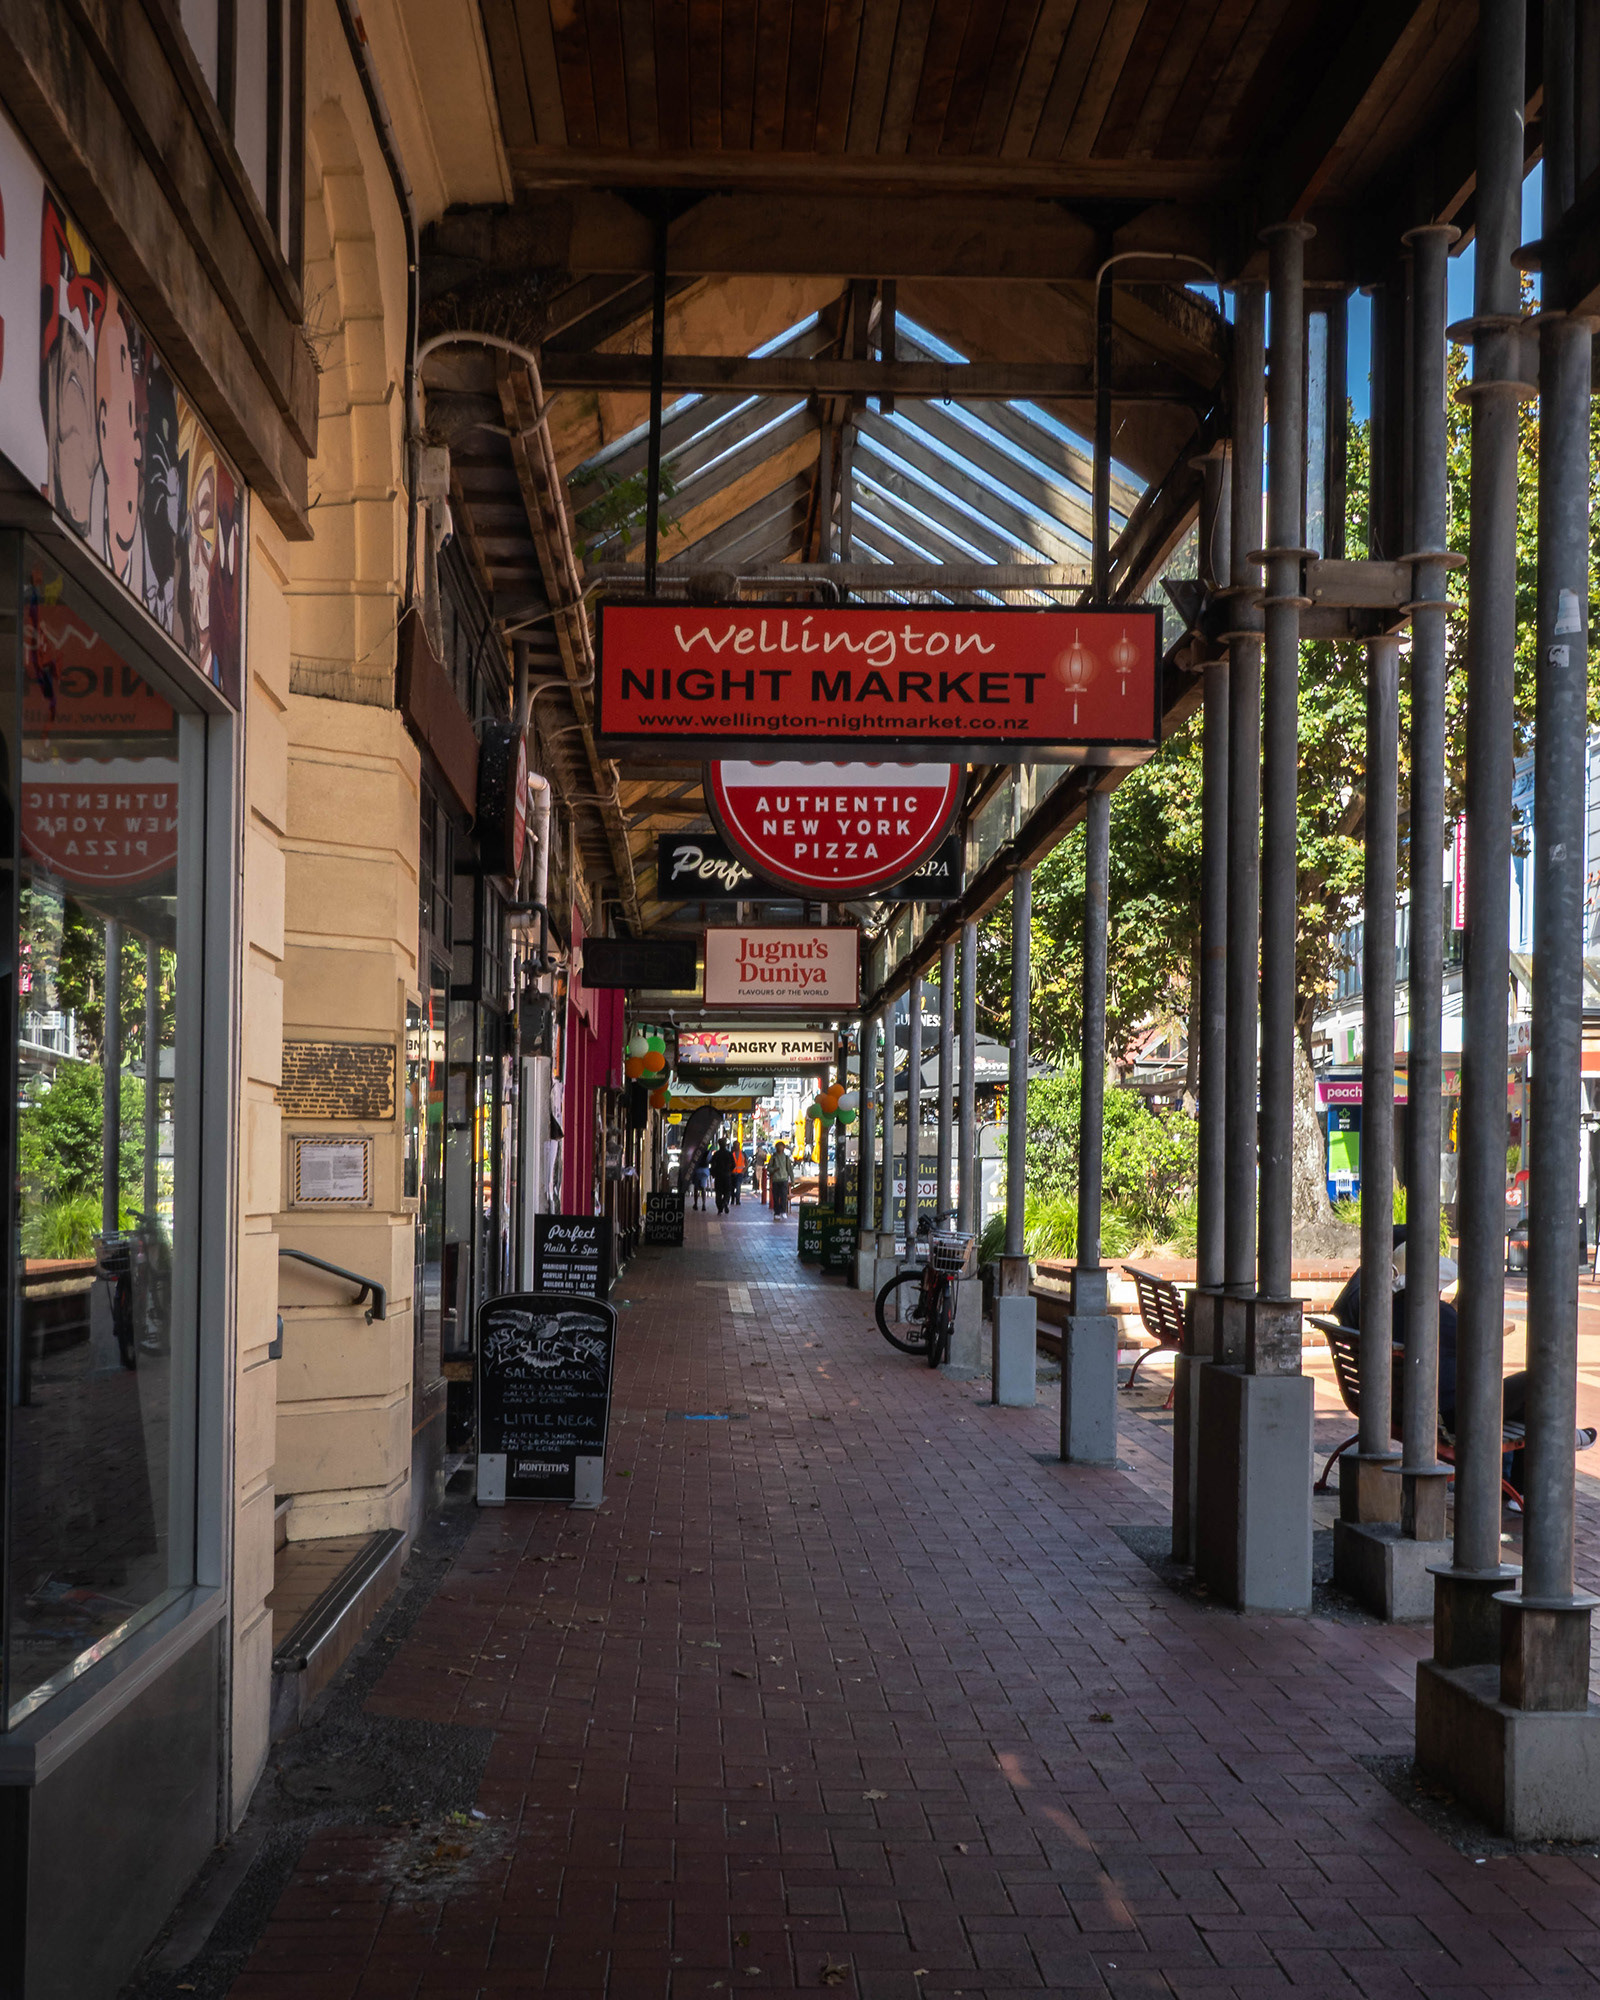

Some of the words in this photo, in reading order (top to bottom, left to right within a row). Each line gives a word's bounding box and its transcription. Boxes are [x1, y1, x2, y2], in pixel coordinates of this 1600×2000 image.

[674, 616, 996, 666] Wellington
[620, 668, 792, 701] NIGHT
[811, 671, 1046, 704] MARKET
[637, 713, 1029, 730] www.wellington-nightmarket.co.nz
[755, 796, 918, 813] AUTHENTIC
[762, 819, 819, 836] NEW
[837, 819, 911, 836] YORK
[795, 843, 879, 859] PIZZA
[671, 845, 754, 892] Perf
[735, 937, 829, 964] Jugnu's
[740, 962, 827, 988] Duniya
[738, 989, 775, 997] FLAVOURS
[776, 989, 787, 997] OF
[788, 989, 802, 997] THE
[803, 989, 830, 997] WORLD
[728, 1041, 777, 1054] ANGRY
[781, 1041, 834, 1056] RAMEN
[650, 1196, 681, 1210] GIFT
[646, 1210, 684, 1224] SHOP
[548, 1224, 596, 1242] Perfect
[830, 1236, 857, 1244] COFFE
[543, 1242, 567, 1254] Nails
[570, 1243, 578, 1254] &
[581, 1243, 599, 1257] Spa
[804, 1239, 820, 1250] $20
[517, 1339, 565, 1357] SLICE
[543, 1368, 594, 1382] CLASSIC
[504, 1413, 554, 1426] LITTLE
[557, 1414, 598, 1428] NECK
[519, 1462, 570, 1472] MONTEITH'S
